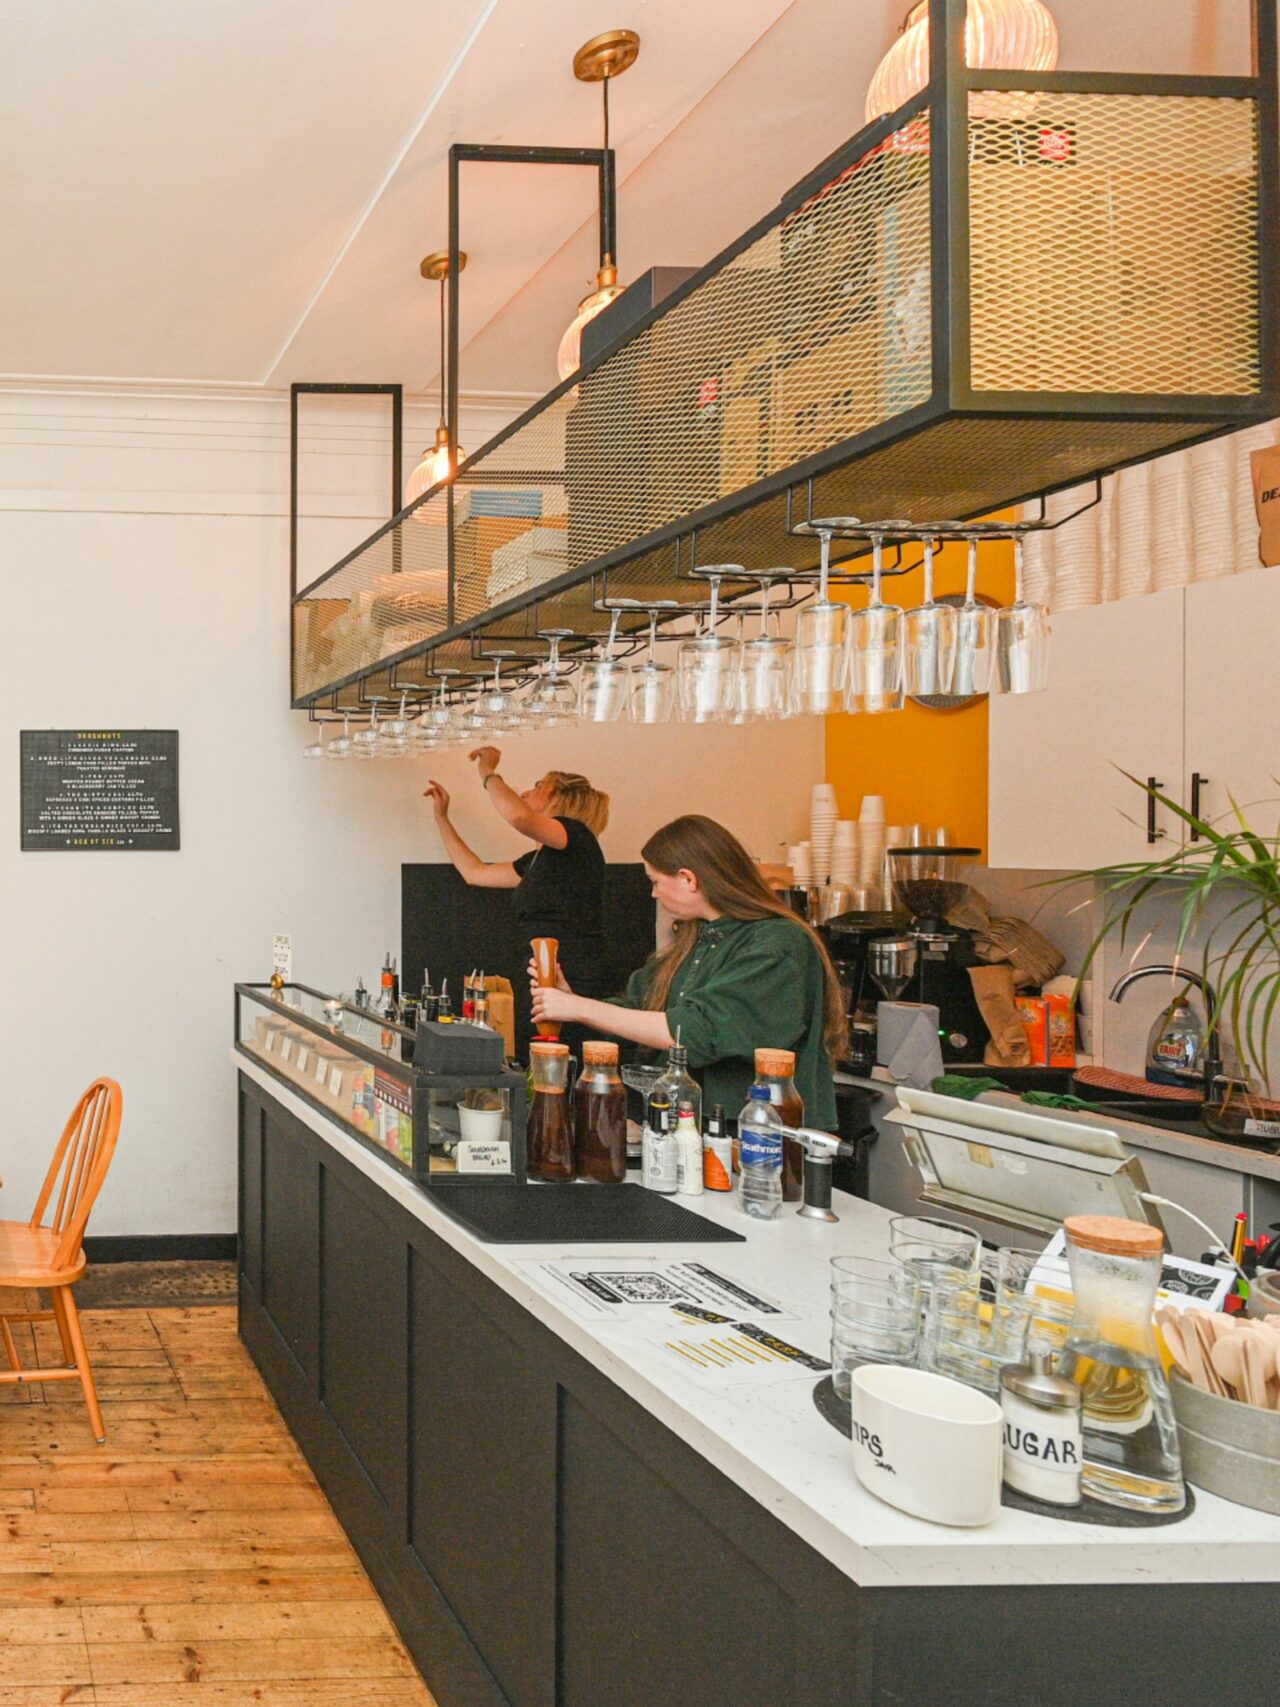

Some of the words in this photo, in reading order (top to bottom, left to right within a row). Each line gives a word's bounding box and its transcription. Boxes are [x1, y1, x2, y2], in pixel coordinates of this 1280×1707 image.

[1262, 487, 1280, 503] DE
[1160, 1044, 1182, 1056] FAIRY
[853, 1421, 884, 1458] IPS
[1003, 1422, 1078, 1464] UGAR
